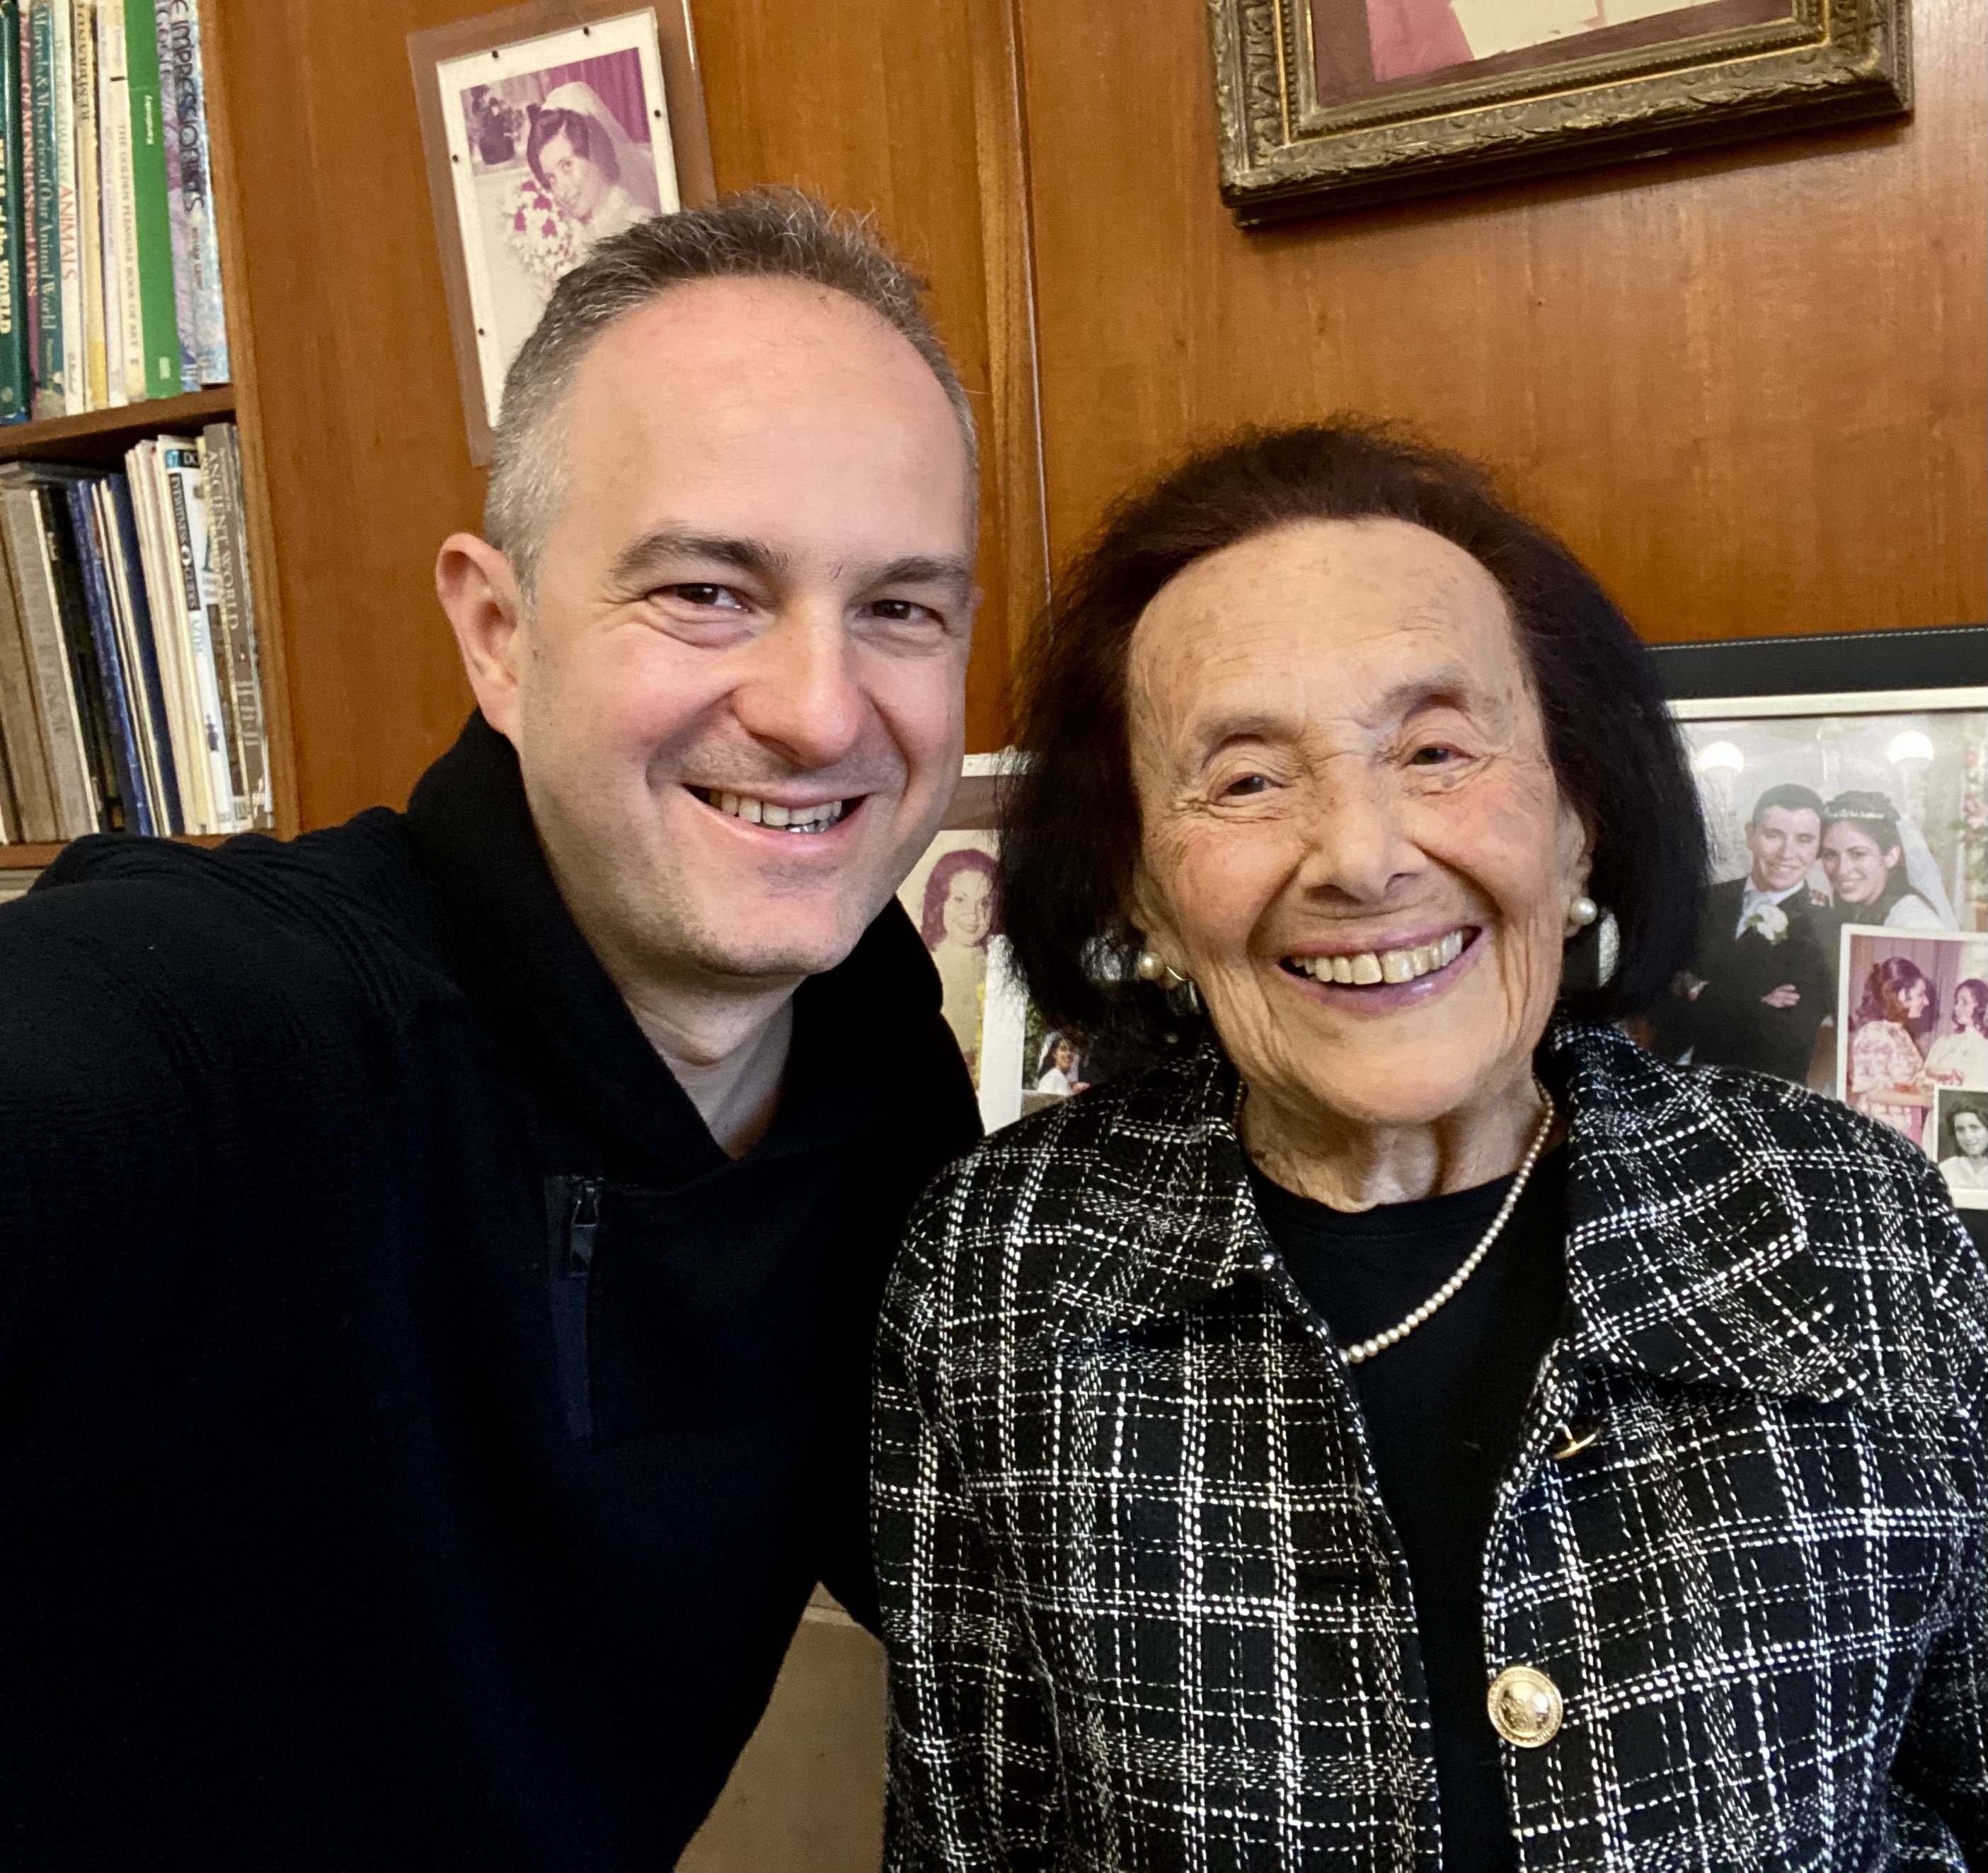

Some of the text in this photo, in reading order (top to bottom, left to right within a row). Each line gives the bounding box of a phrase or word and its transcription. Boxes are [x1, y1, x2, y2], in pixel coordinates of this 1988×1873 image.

[33, 9, 49, 71] Marvels
[35, 74, 48, 87] &
[33, 91, 50, 166] Mysteries
[119, 125, 127, 147] THE
[171, 20, 205, 213] IMPRESSIONISTS
[22, 111, 34, 208] MONKEYS
[38, 168, 52, 186] of
[120, 151, 130, 200] GOLDEN
[40, 187, 52, 218] Our
[40, 223, 54, 277] Animal
[59, 186, 76, 280] ANIMALS
[123, 205, 133, 261] PLEASURE
[25, 246, 37, 297] APES
[41, 282, 57, 330] World
[207, 451, 229, 545] ANCIENT
[221, 550, 239, 631] WORLD
